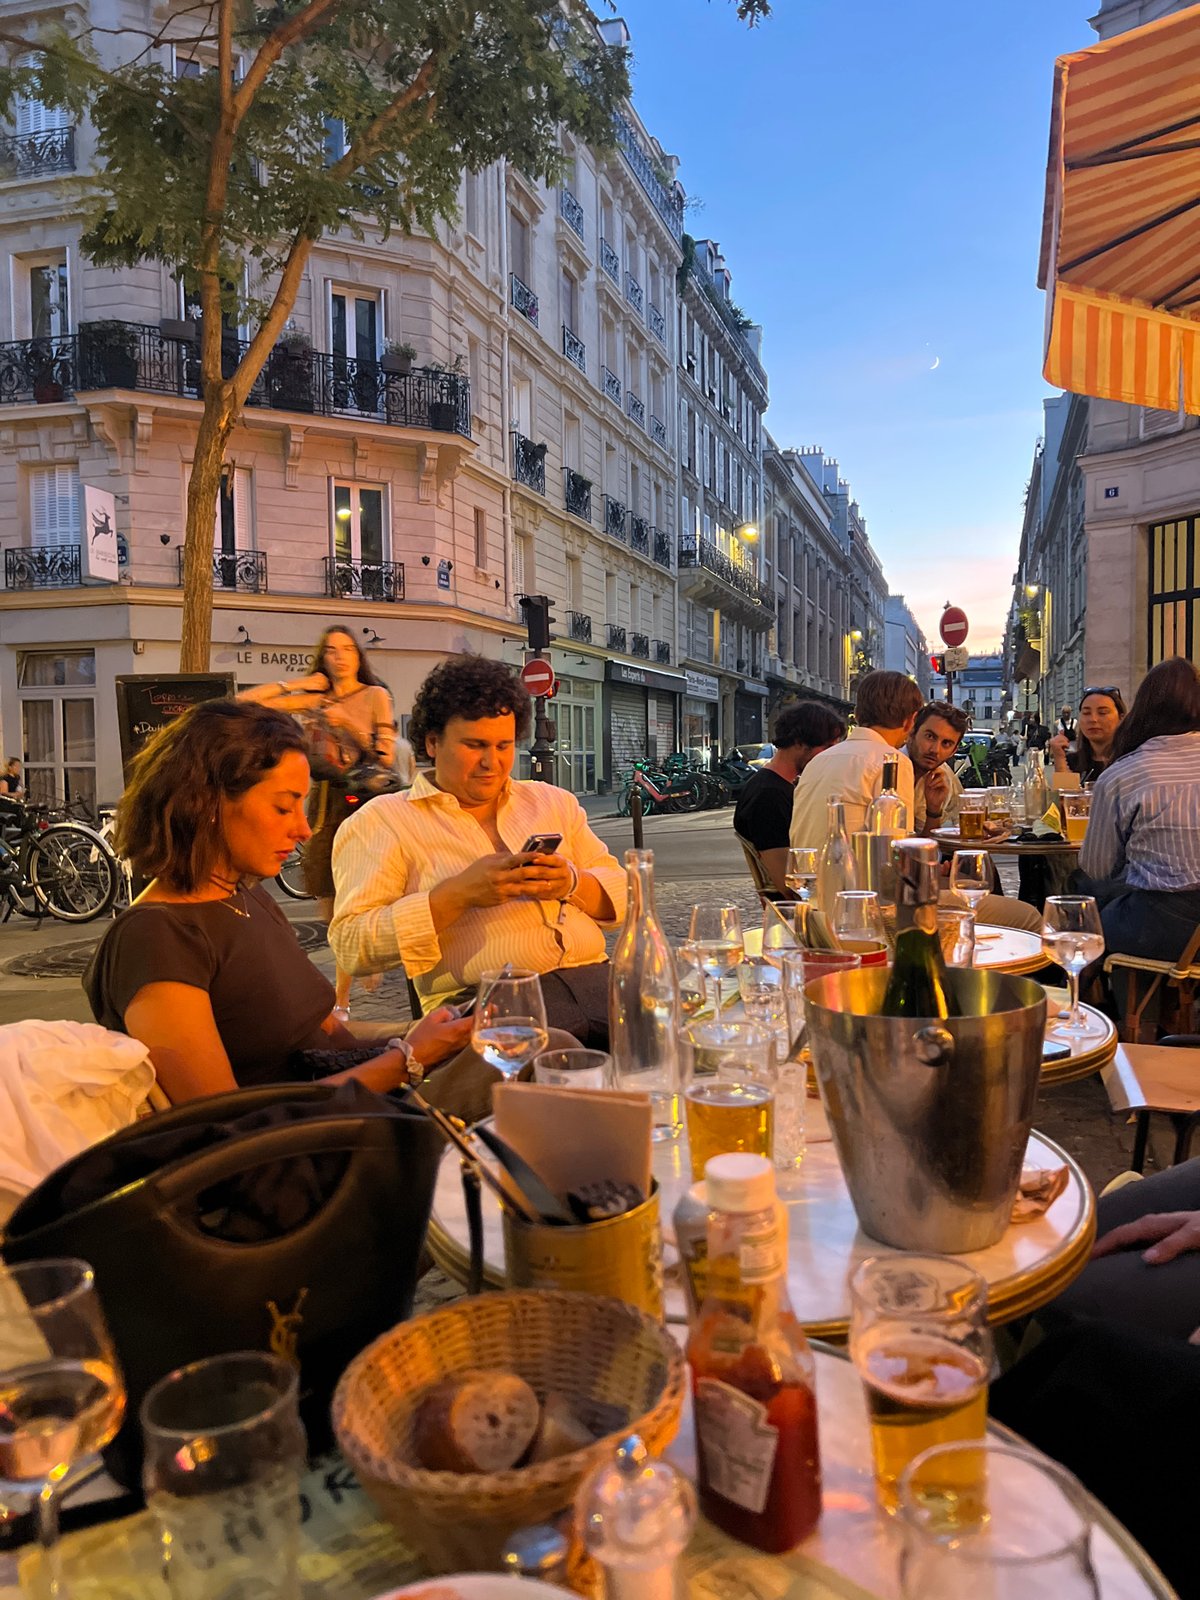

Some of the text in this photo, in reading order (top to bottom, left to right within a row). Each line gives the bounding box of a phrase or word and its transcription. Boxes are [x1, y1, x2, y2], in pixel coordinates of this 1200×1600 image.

[1109, 489, 1115, 497] 6
[237, 651, 315, 665] LE BARBIC
[628, 667, 641, 683] Experts
